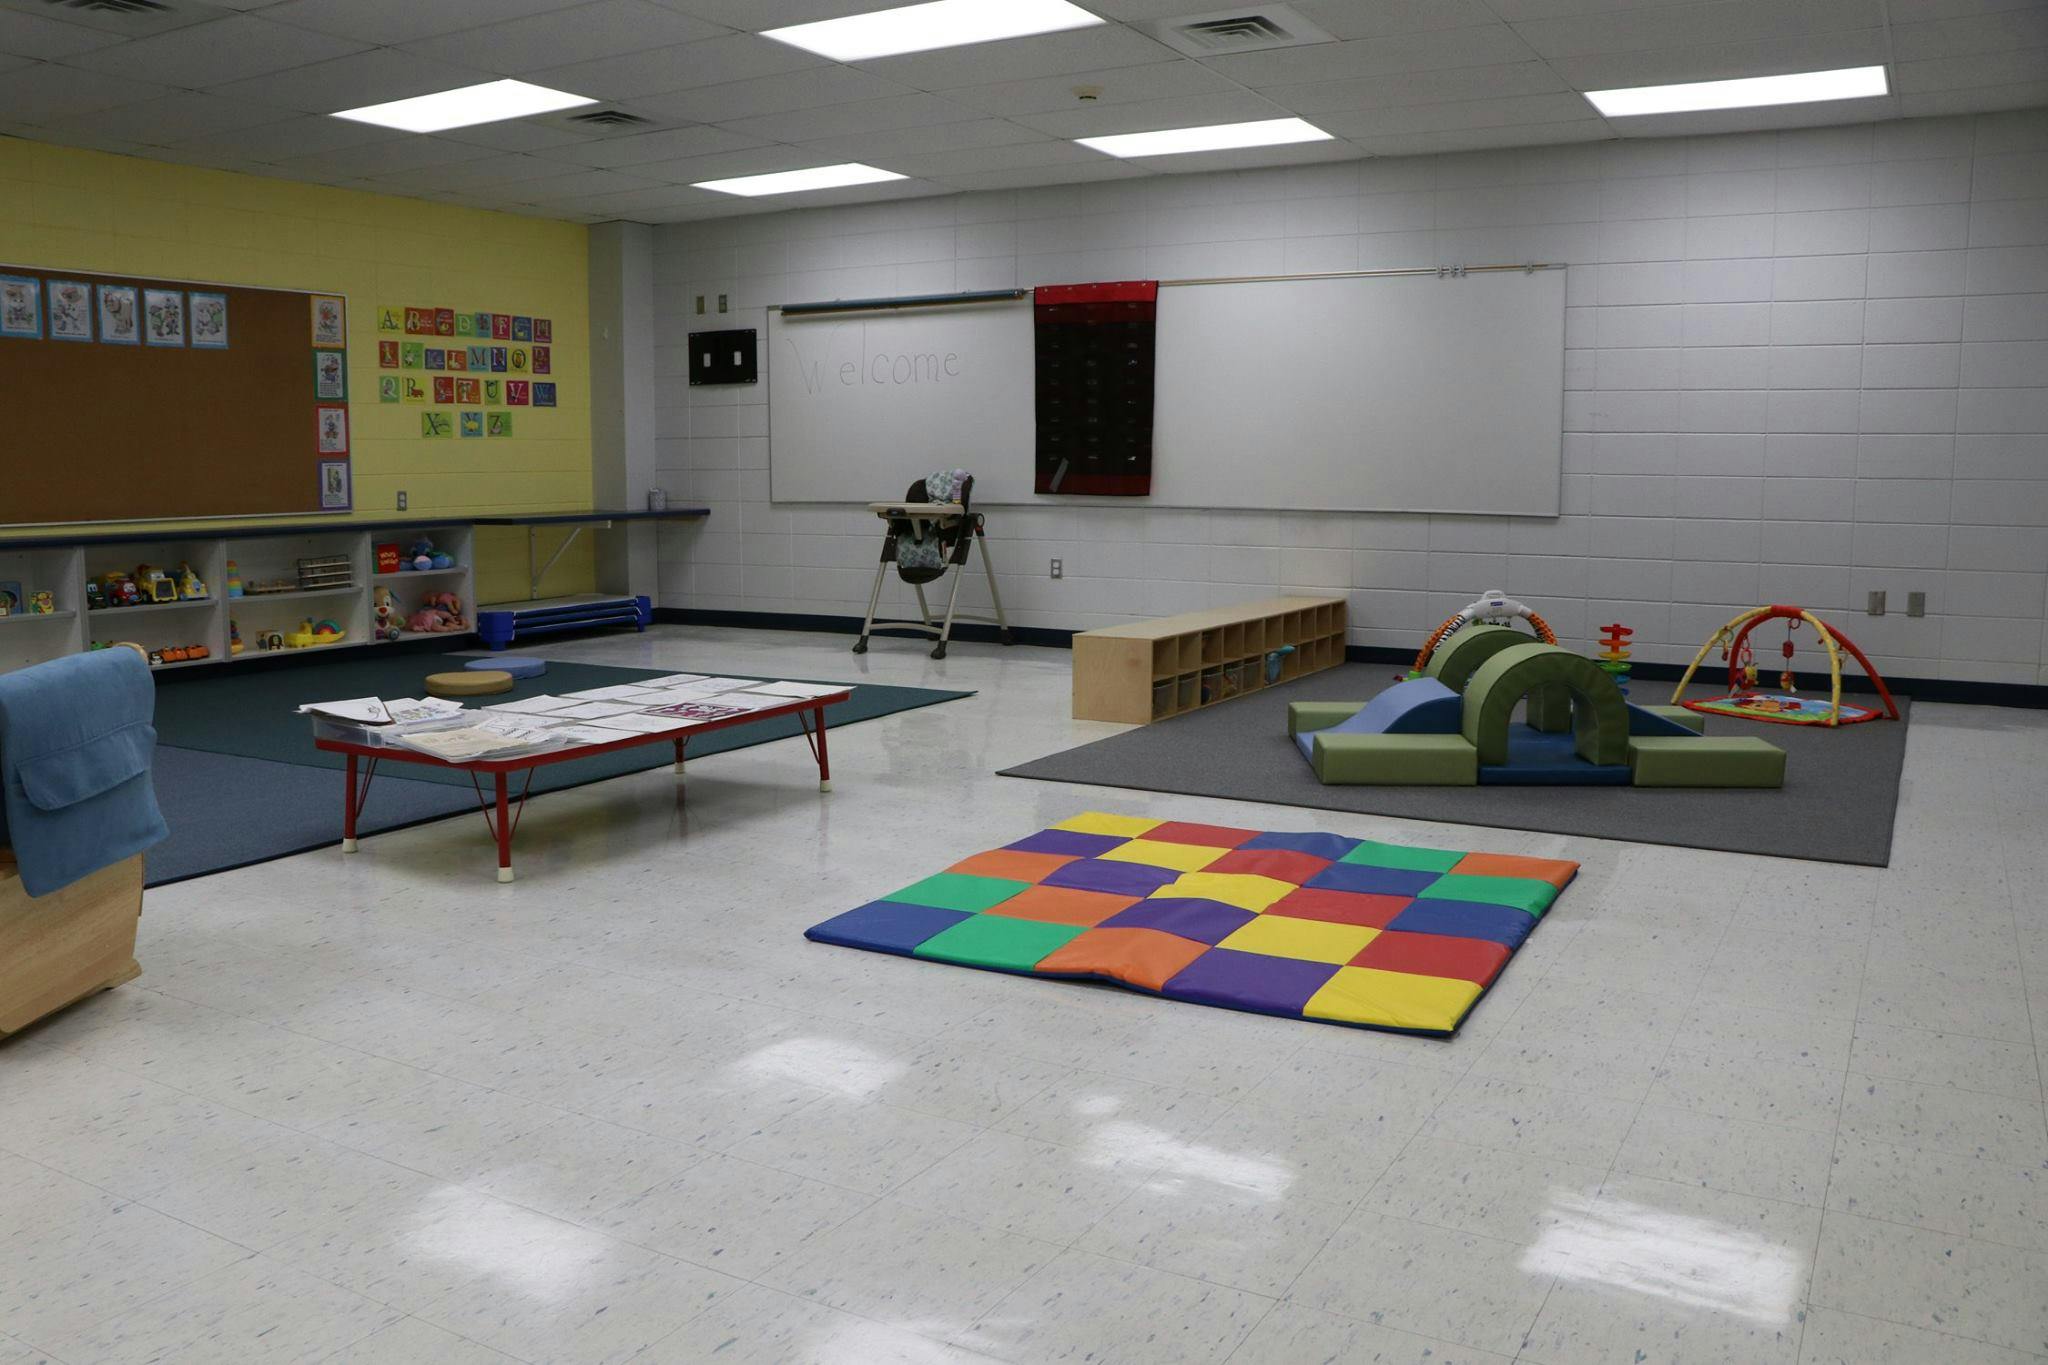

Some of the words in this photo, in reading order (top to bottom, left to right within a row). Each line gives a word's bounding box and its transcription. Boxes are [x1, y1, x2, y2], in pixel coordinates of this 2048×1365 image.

[382, 309, 400, 329] A
[407, 310, 420, 332] B
[458, 315, 471, 332] D
[495, 316, 508, 335] F
[535, 320, 550, 337] H
[448, 351, 460, 368] L
[470, 347, 487, 366] M
[493, 348, 506, 366] N
[511, 349, 526, 369] O
[785, 321, 960, 395] Welcome
[381, 376, 397, 398] Q
[457, 380, 473, 402] T
[484, 379, 499, 399] U
[508, 382, 525, 403] V
[534, 383, 549, 401] W
[425, 413, 442, 436] X
[489, 415, 502, 434] Z
